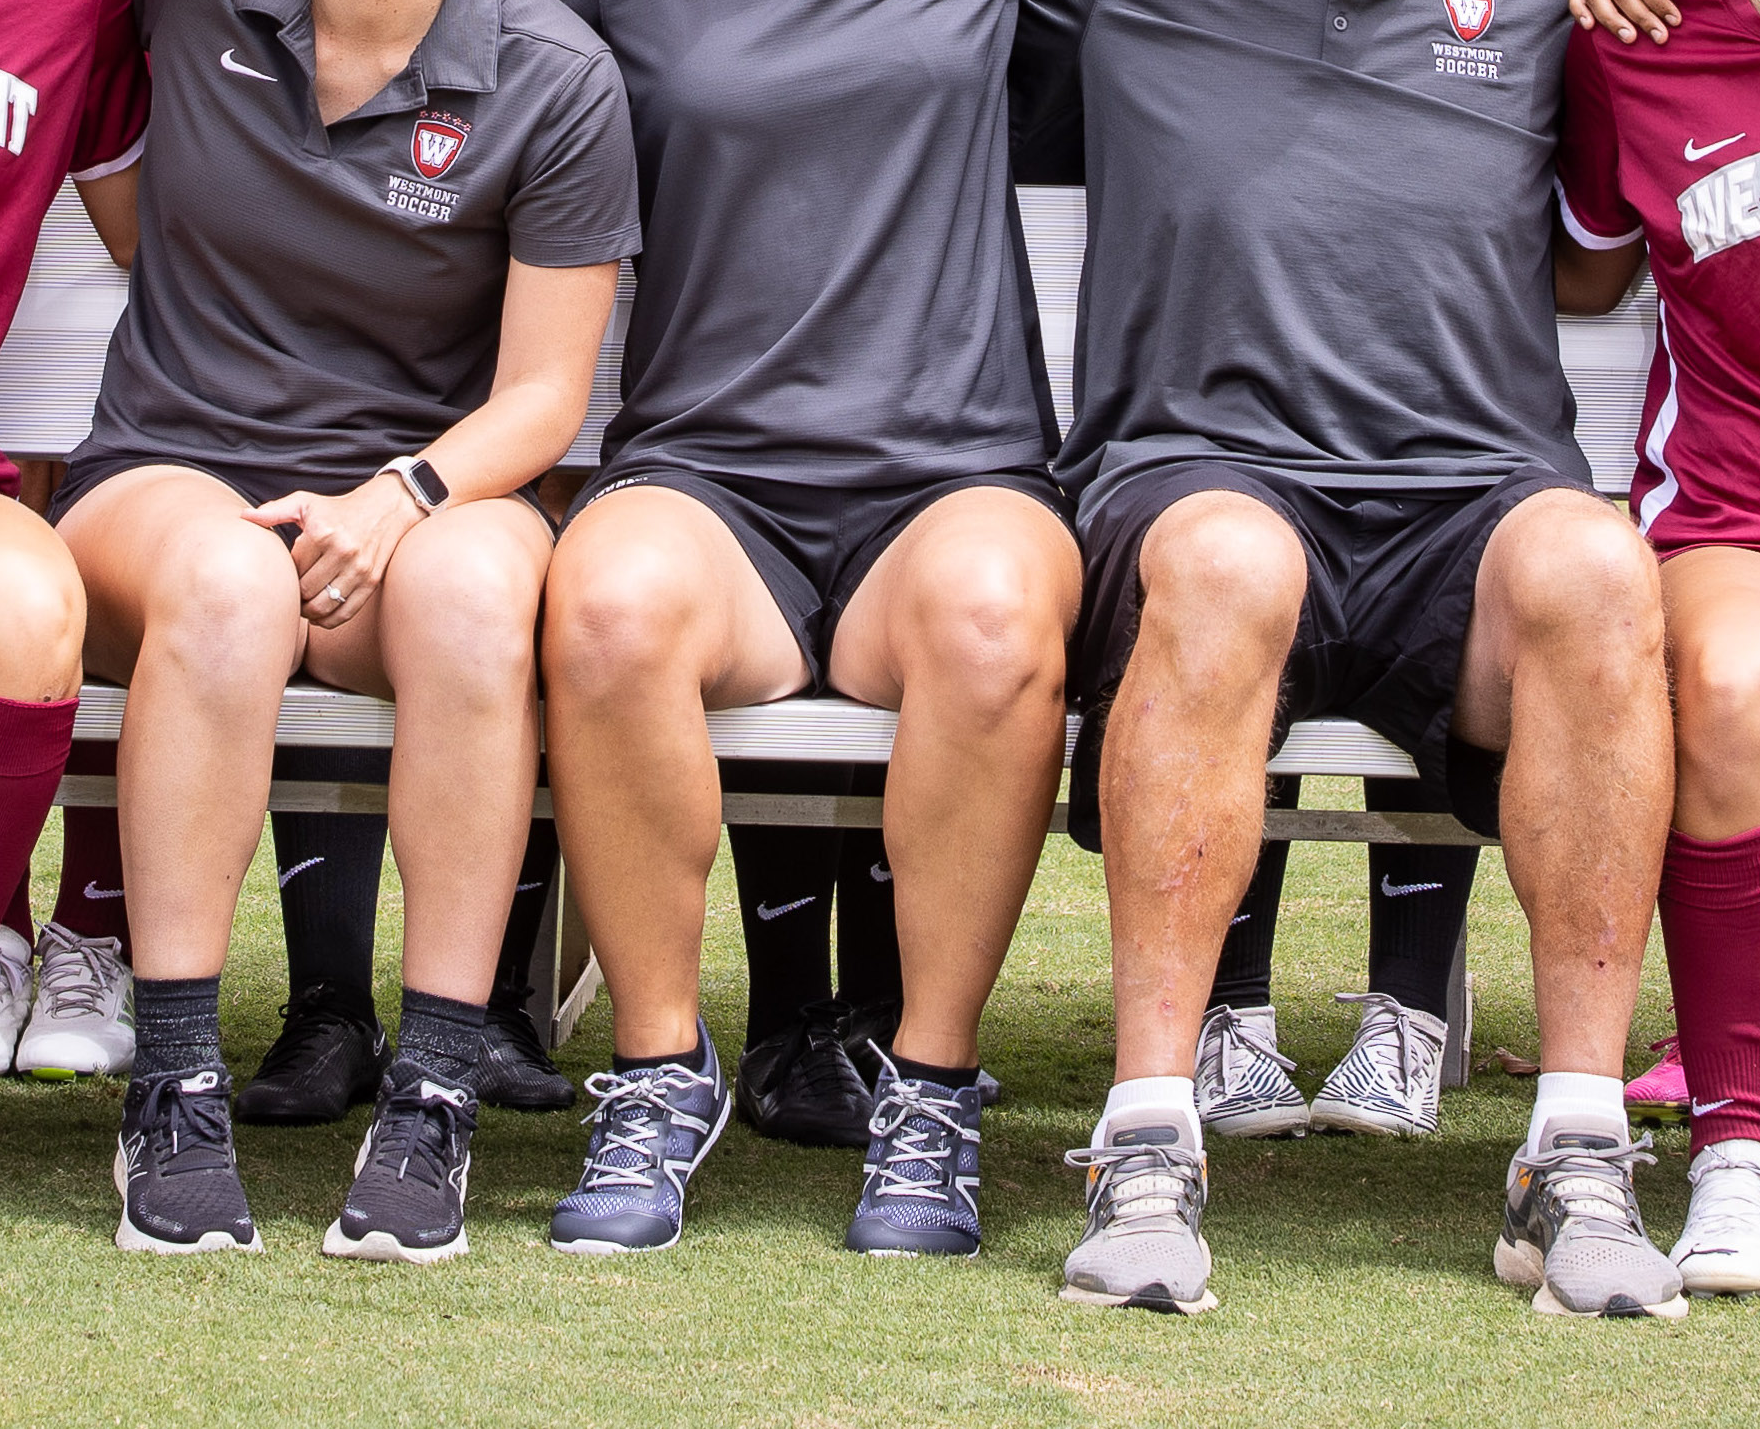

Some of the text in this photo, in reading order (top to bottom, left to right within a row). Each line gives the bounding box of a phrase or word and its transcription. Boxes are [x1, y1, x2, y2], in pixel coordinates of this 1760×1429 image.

[1431, 42, 1503, 63] WESTMONT
[1435, 57, 1499, 80] SOCCER
[388, 174, 460, 205] WESTMONT
[386, 190, 452, 222] SOCCER
